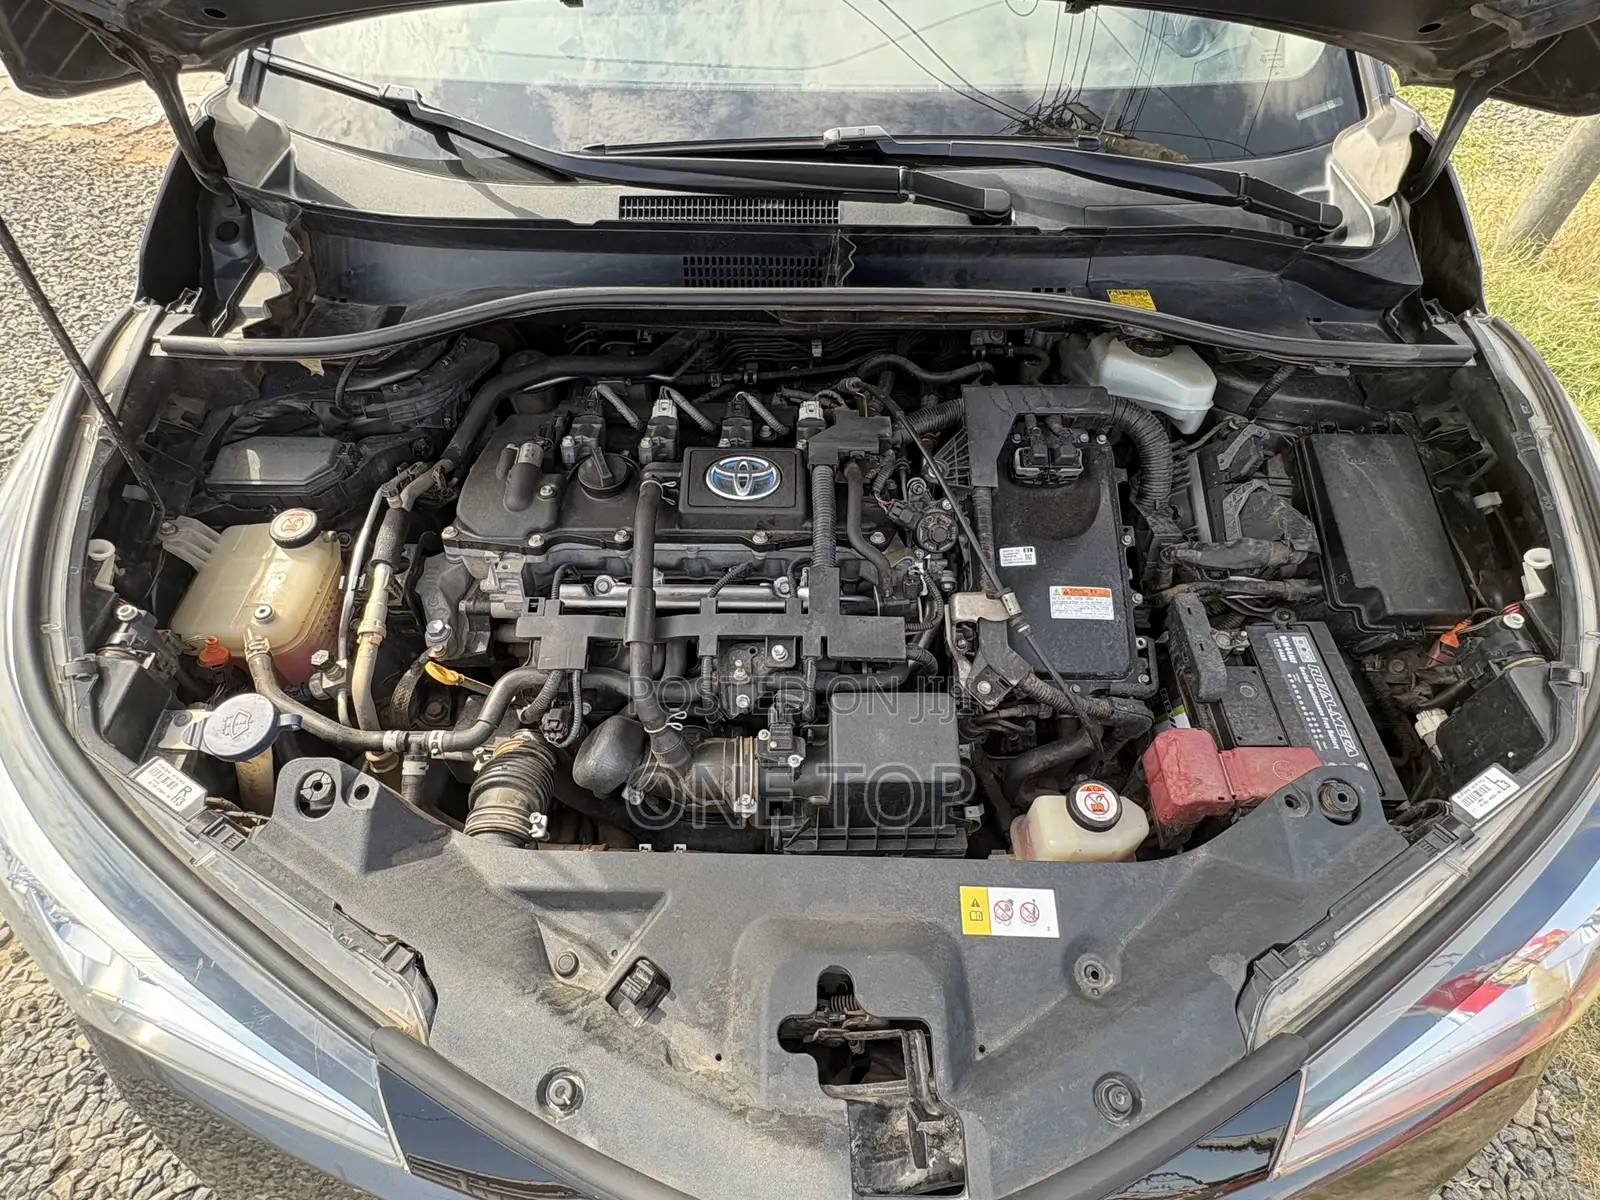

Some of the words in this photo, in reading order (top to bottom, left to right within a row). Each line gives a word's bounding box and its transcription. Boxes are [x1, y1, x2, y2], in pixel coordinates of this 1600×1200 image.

[1299, 666, 1311, 683] Sealed
[1307, 683, 1325, 717] Maintenance
[1322, 717, 1332, 729] Free
[1327, 729, 1340, 750] Battery
[1308, 664, 1337, 713] ROYAL
[1329, 711, 1359, 757] MEGA
[178, 785, 192, 797] R
